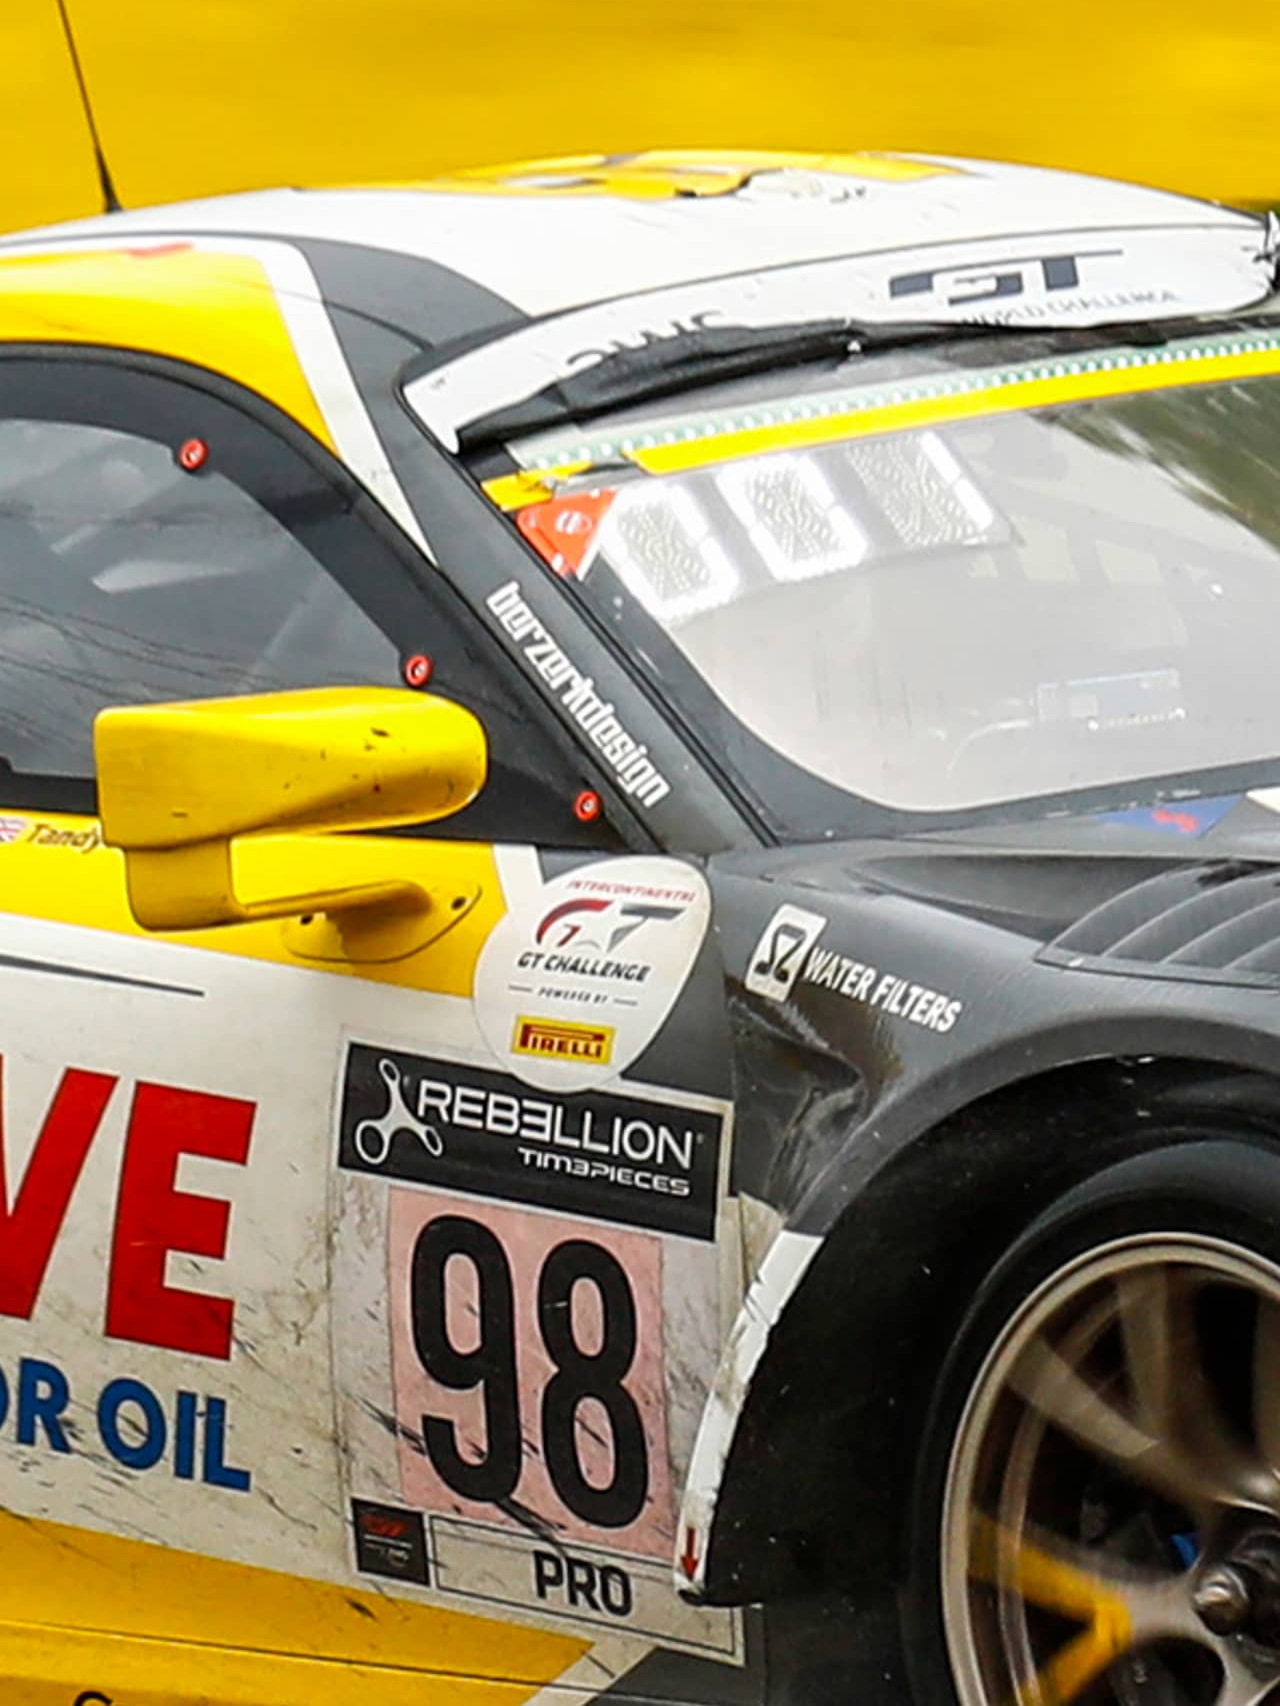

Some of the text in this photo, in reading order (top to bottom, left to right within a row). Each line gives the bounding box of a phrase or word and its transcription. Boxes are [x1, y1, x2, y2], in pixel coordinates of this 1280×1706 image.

[517, 951, 652, 983] GT CHALLENGE
[537, 987, 590, 1003] POWERED
[803, 947, 962, 1033] WATER FILTERS
[519, 1023, 606, 1059] PIRELLI
[417, 1079, 694, 1170] REBELLION
[409, 1214, 651, 1530] 98
[97, 1377, 252, 1494] OIL
[532, 1549, 633, 1617] PRO
